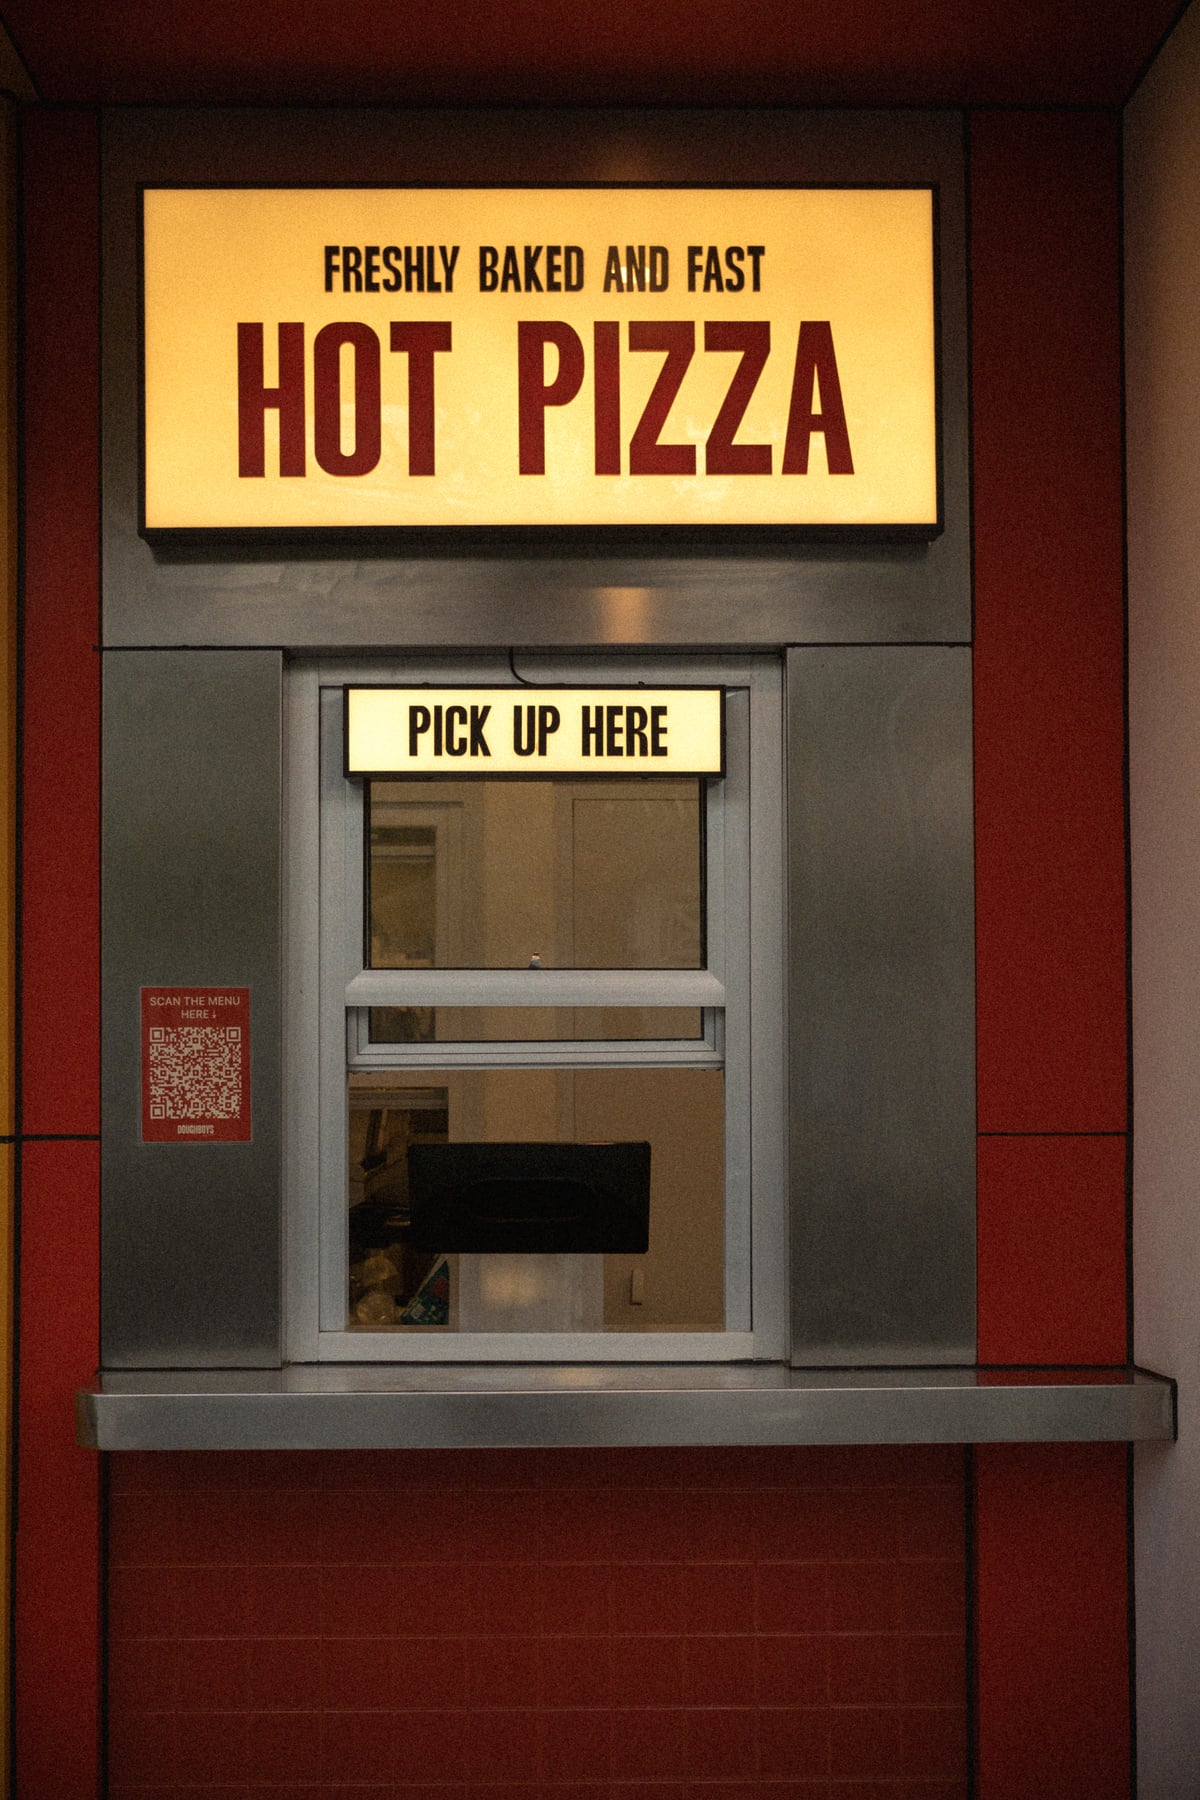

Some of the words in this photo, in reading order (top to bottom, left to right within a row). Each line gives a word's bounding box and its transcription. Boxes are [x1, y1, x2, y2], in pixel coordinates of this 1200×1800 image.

[324, 245, 460, 293] FRESHLY
[479, 245, 584, 293] BAKED
[603, 245, 669, 293] AND
[687, 245, 765, 293] FAST
[237, 321, 452, 478] HOT
[517, 320, 855, 476] PIZZA
[409, 705, 492, 757] PICK
[513, 705, 560, 757] UP
[582, 705, 668, 757] HERE
[150, 996, 181, 1007] SCAN
[184, 996, 205, 1006] THE
[208, 996, 240, 1006] MENU
[181, 1009, 209, 1019] HERE
[177, 1124, 215, 1135] DOUGHBOYS
